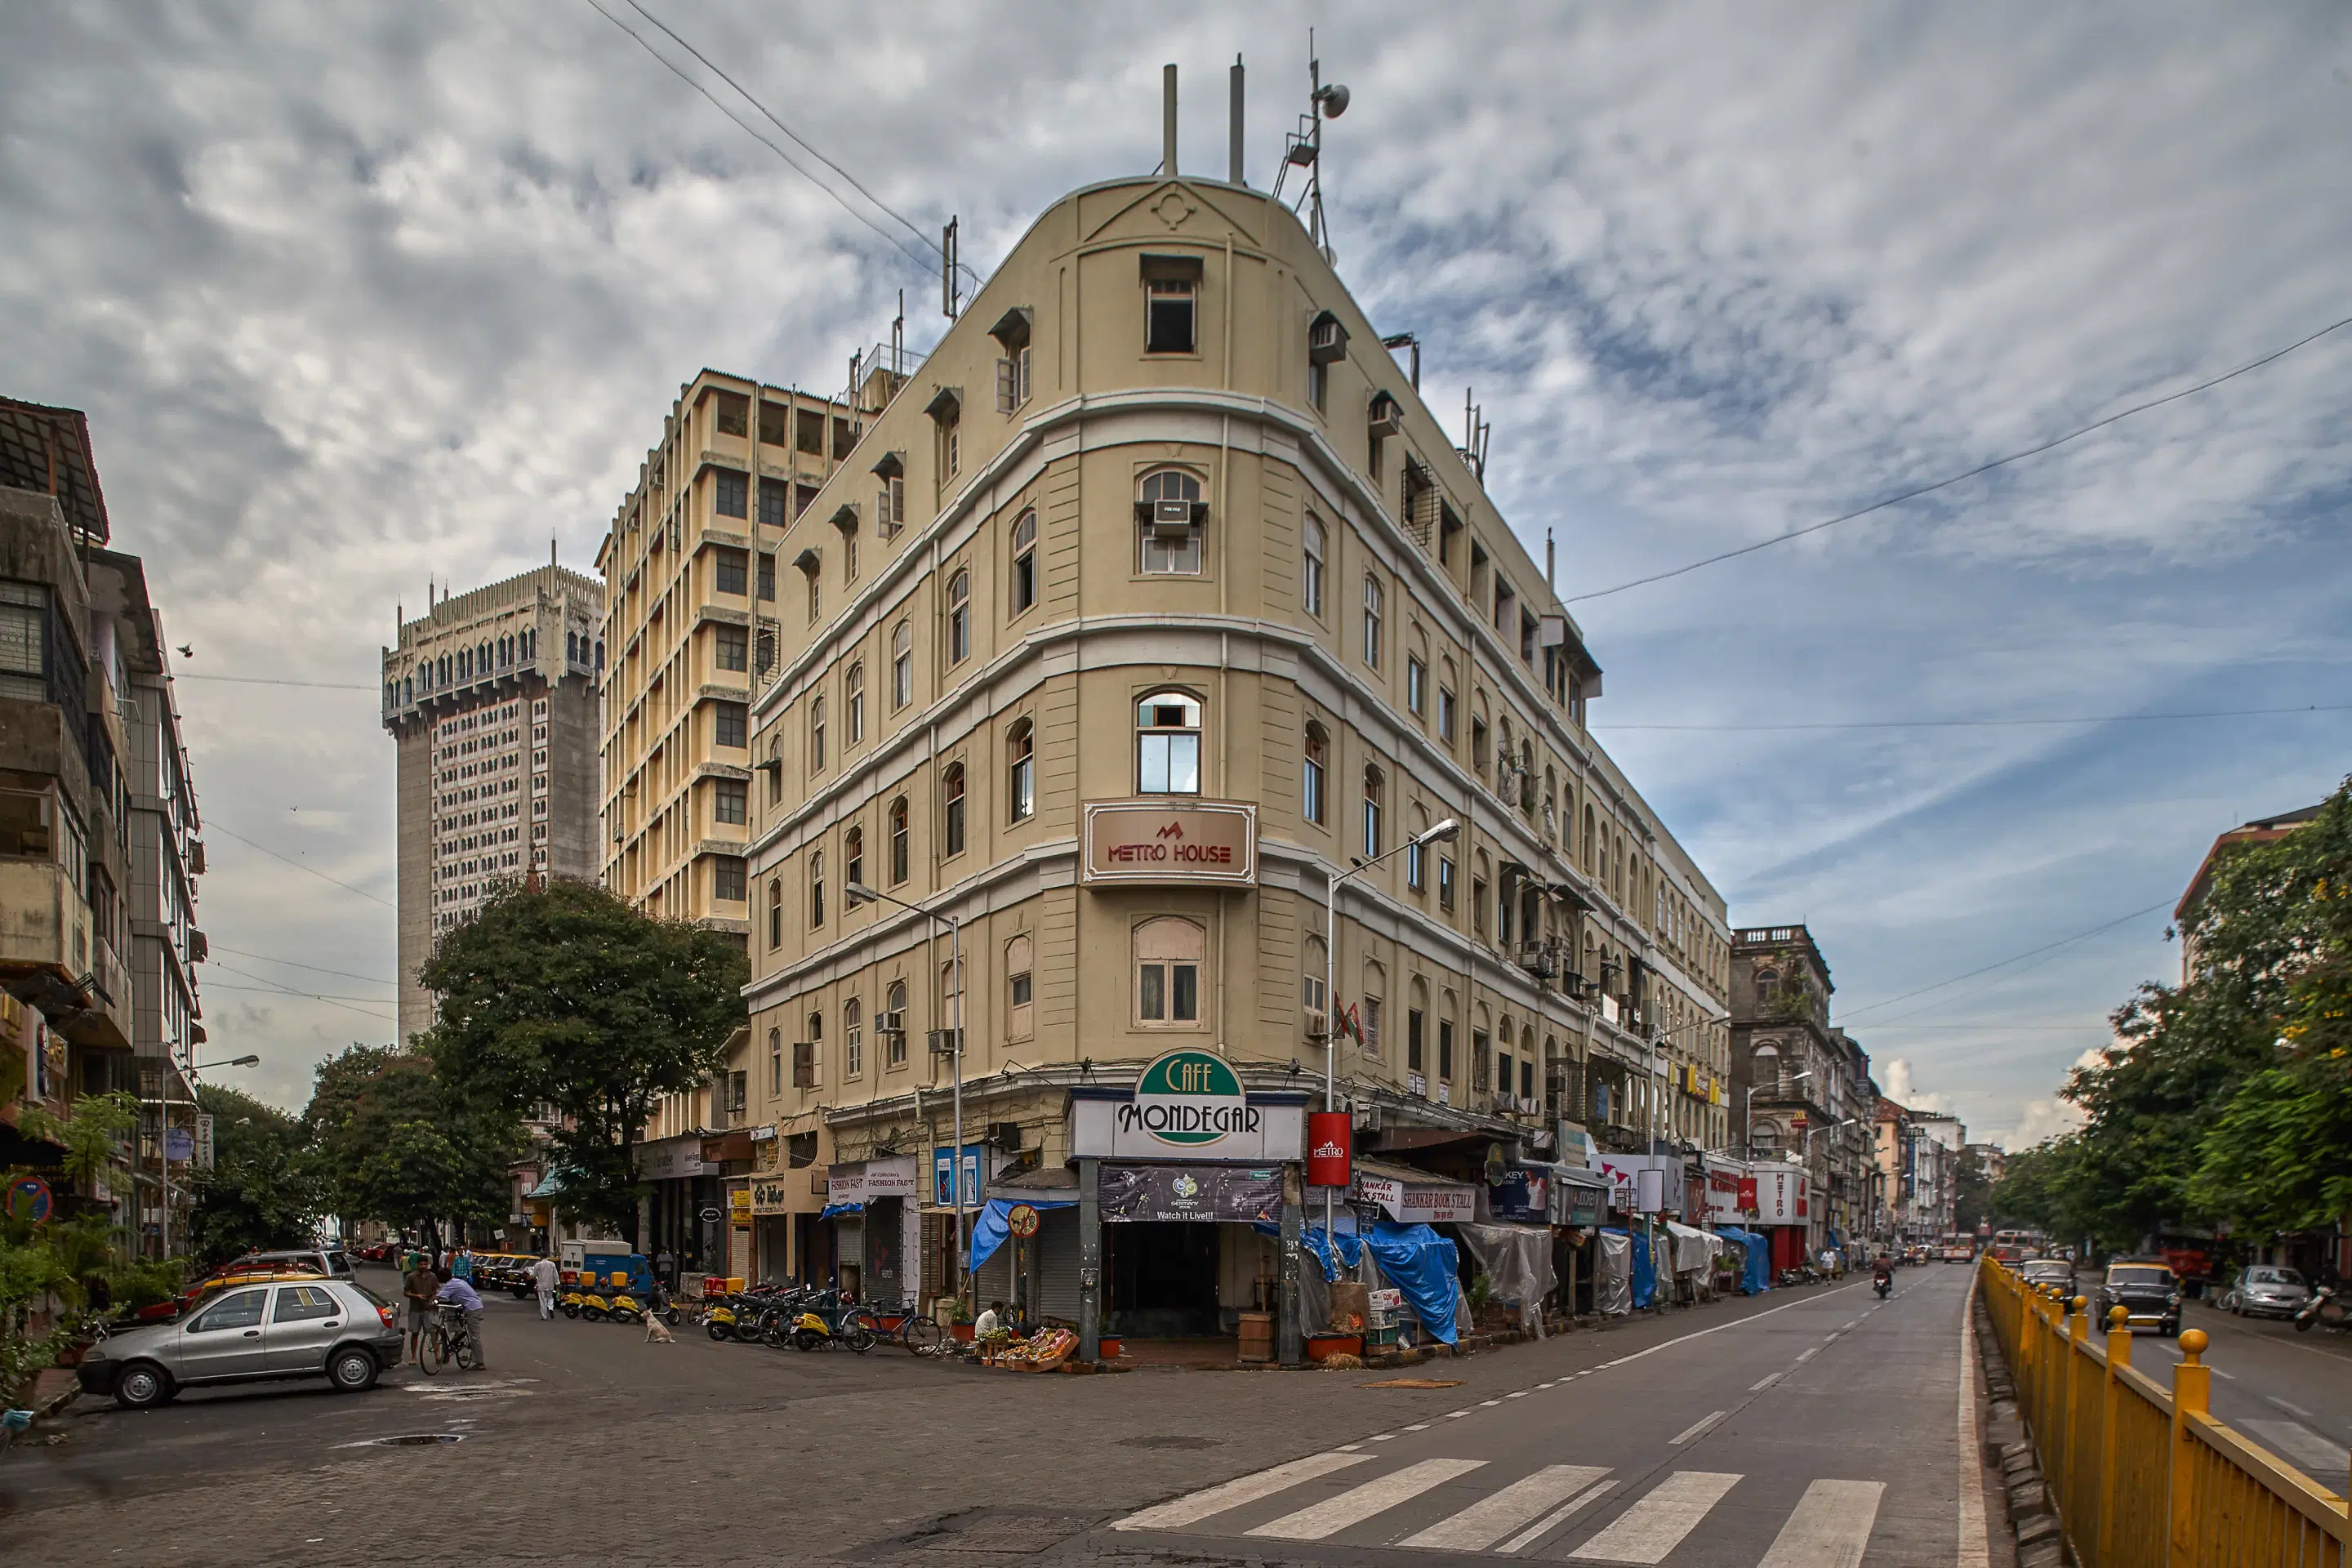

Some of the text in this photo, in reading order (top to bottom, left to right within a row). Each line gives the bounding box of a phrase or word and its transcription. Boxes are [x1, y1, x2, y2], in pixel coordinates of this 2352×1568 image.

[1108, 844, 1232, 863] METRO HOUSE
[1165, 1059, 1212, 1092] CAFE
[1117, 1104, 1260, 1134] MONDEGAR
[1313, 1147, 1343, 1156] METRO
[831, 1178, 863, 1190] FASHION FAST
[1371, 1192, 1395, 1202] STALL
[1402, 1192, 1472, 1209] SHANKAR BOOK STALL
[1776, 1173, 1784, 1217] METRO
[1156, 1211, 1214, 1220] Watch it Live!!!
